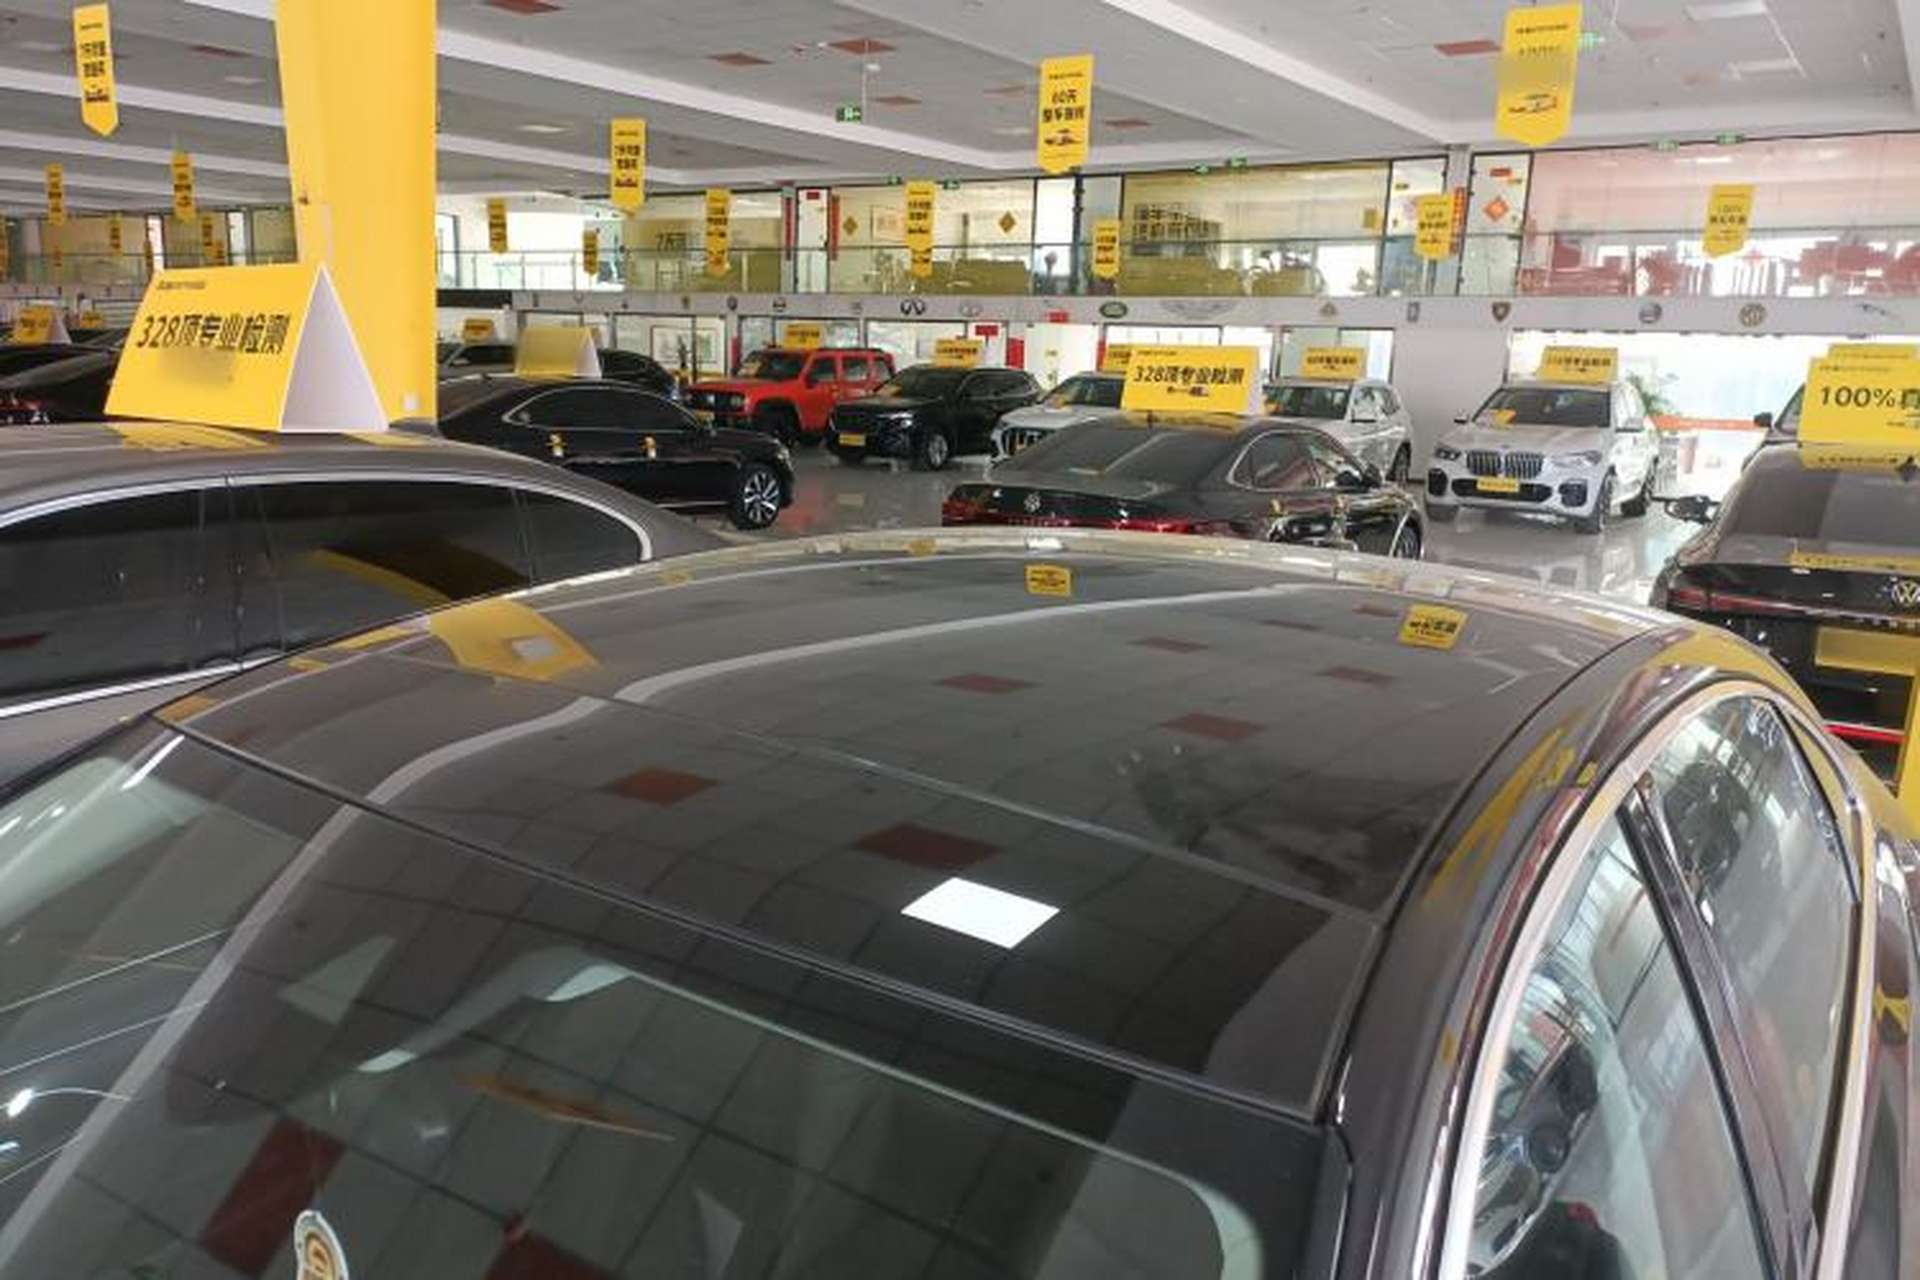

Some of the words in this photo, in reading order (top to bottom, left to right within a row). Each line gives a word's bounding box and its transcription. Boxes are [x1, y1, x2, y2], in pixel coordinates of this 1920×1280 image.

[136, 311, 292, 355] 328项专业检测
